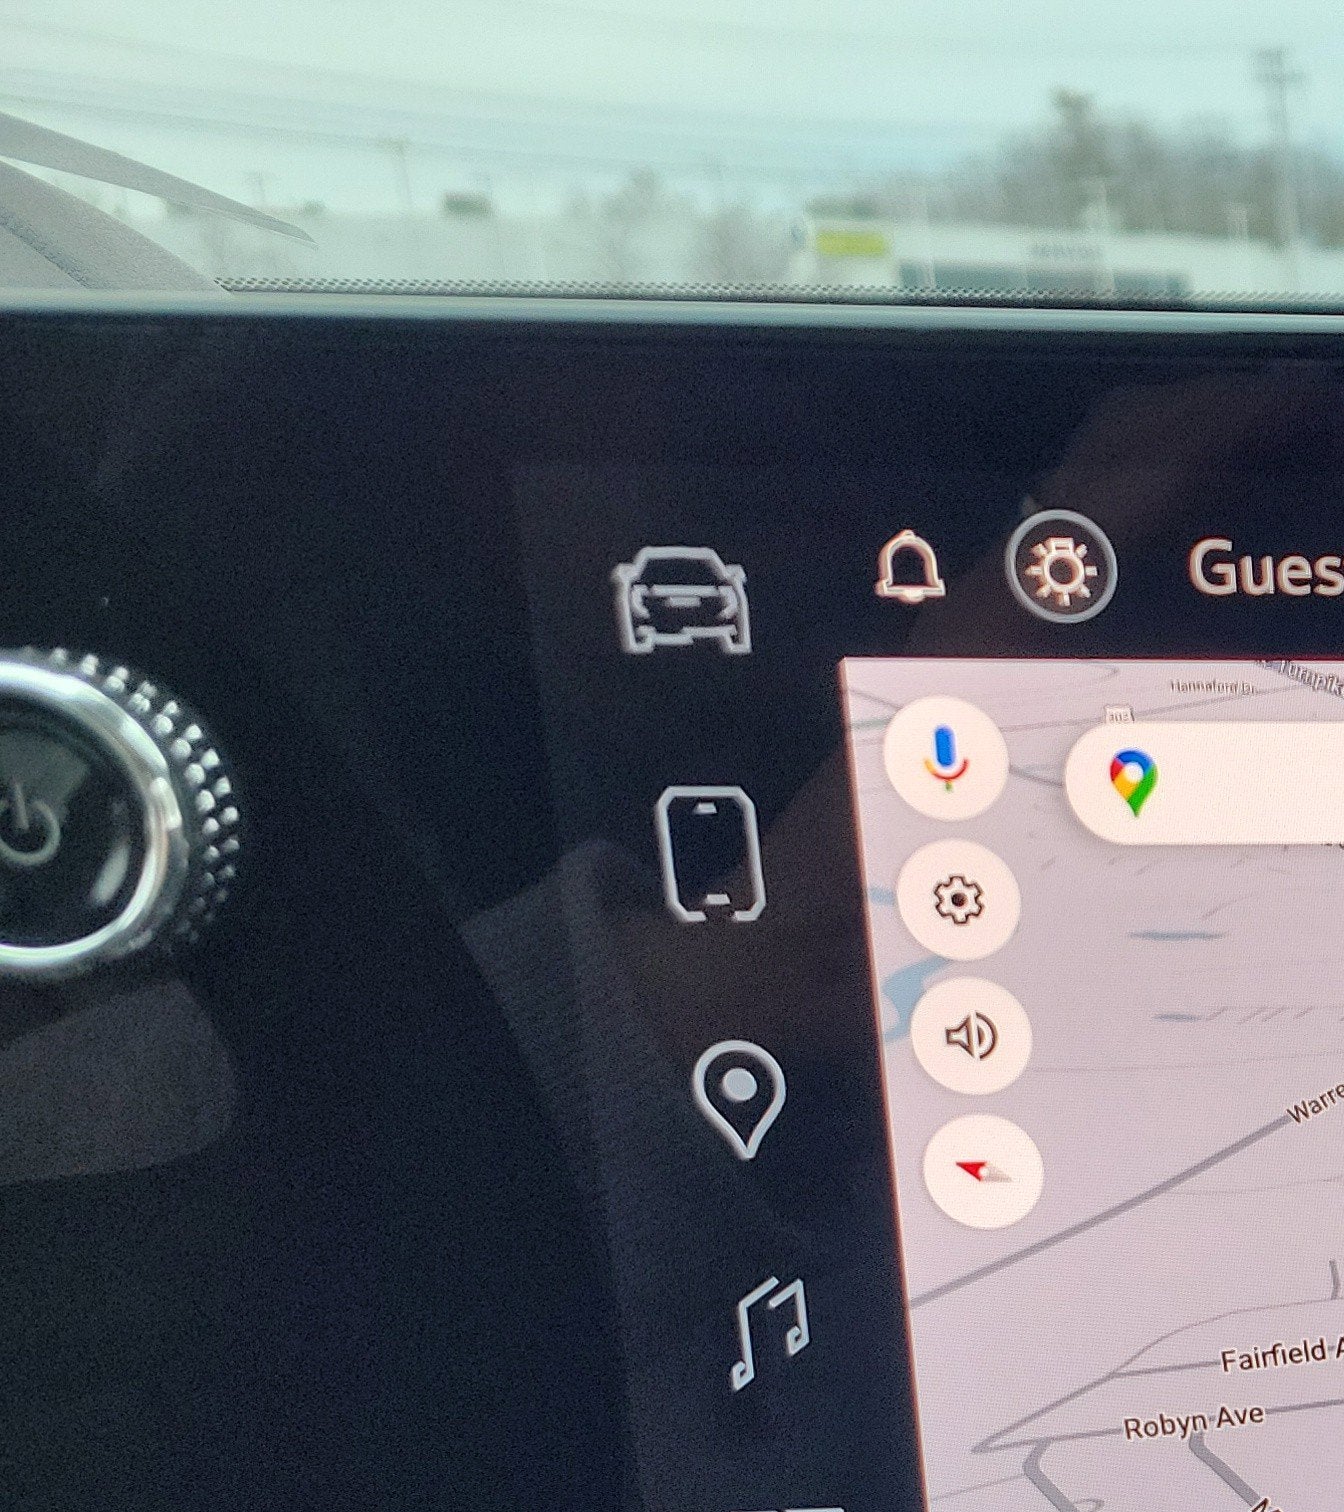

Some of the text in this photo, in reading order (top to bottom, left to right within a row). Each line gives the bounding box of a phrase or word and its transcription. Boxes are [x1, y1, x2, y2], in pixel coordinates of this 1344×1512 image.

[1221, 1338, 1326, 1372] Fairfield
[1124, 1406, 1265, 1440] Robyn Ave
